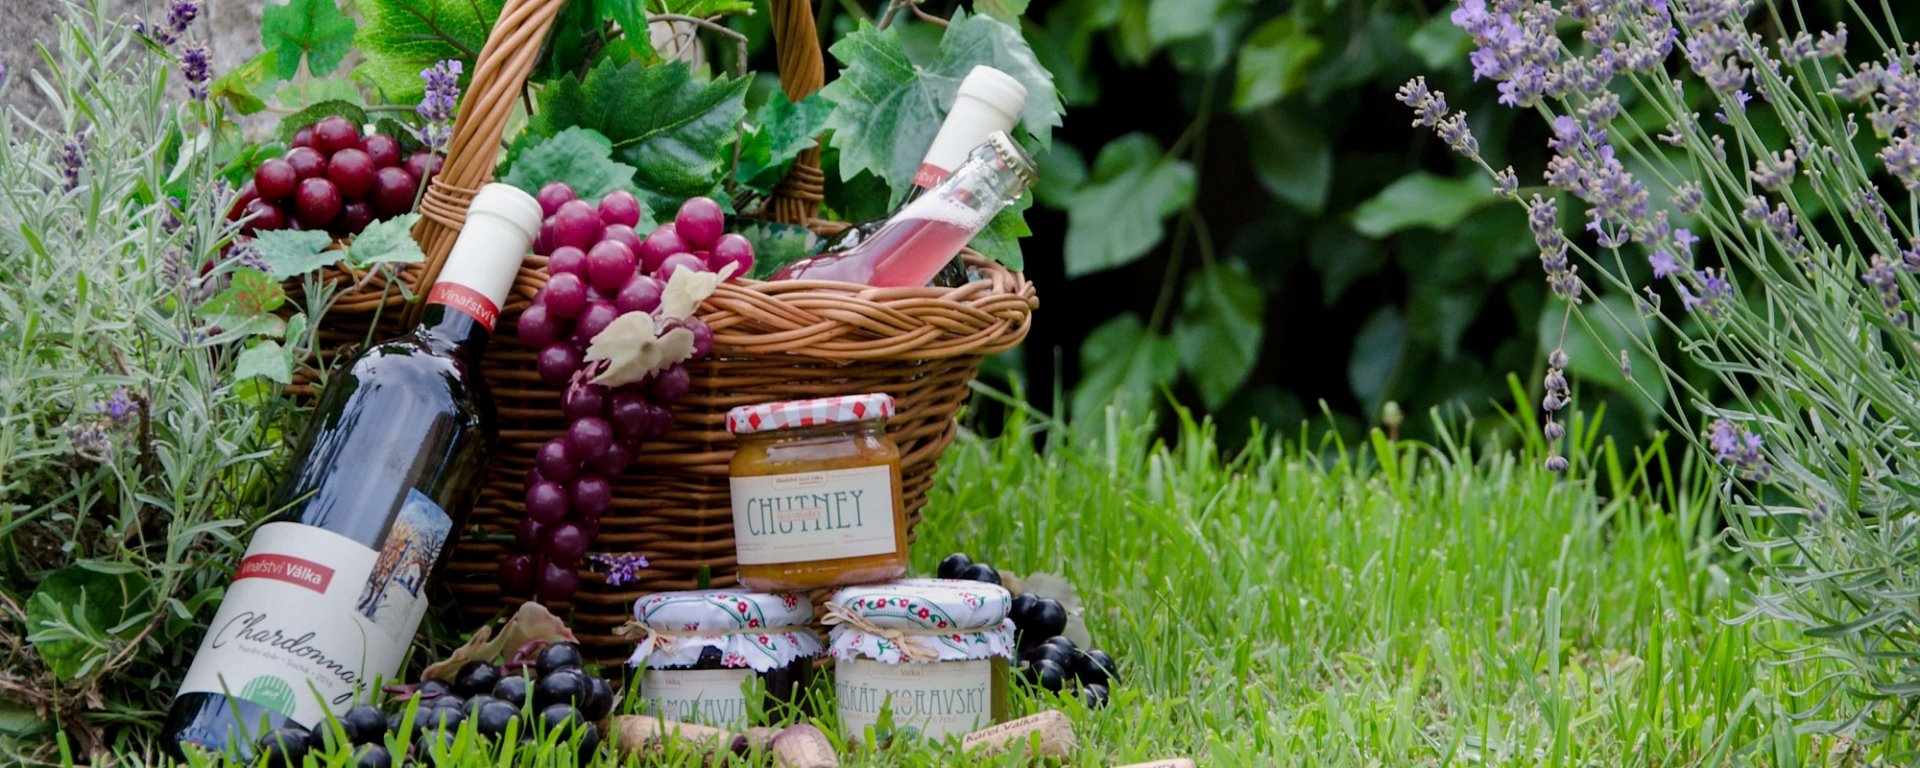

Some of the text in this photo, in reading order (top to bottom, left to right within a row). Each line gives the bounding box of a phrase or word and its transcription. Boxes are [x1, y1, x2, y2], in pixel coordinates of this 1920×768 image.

[440, 288, 491, 321] Vinařství
[747, 489, 864, 536] CHUTNEY
[285, 562, 322, 585] Válka
[212, 610, 368, 705] Chardonnay
[885, 683, 986, 716] MORAVSKÝ
[965, 726, 999, 743] Karel
